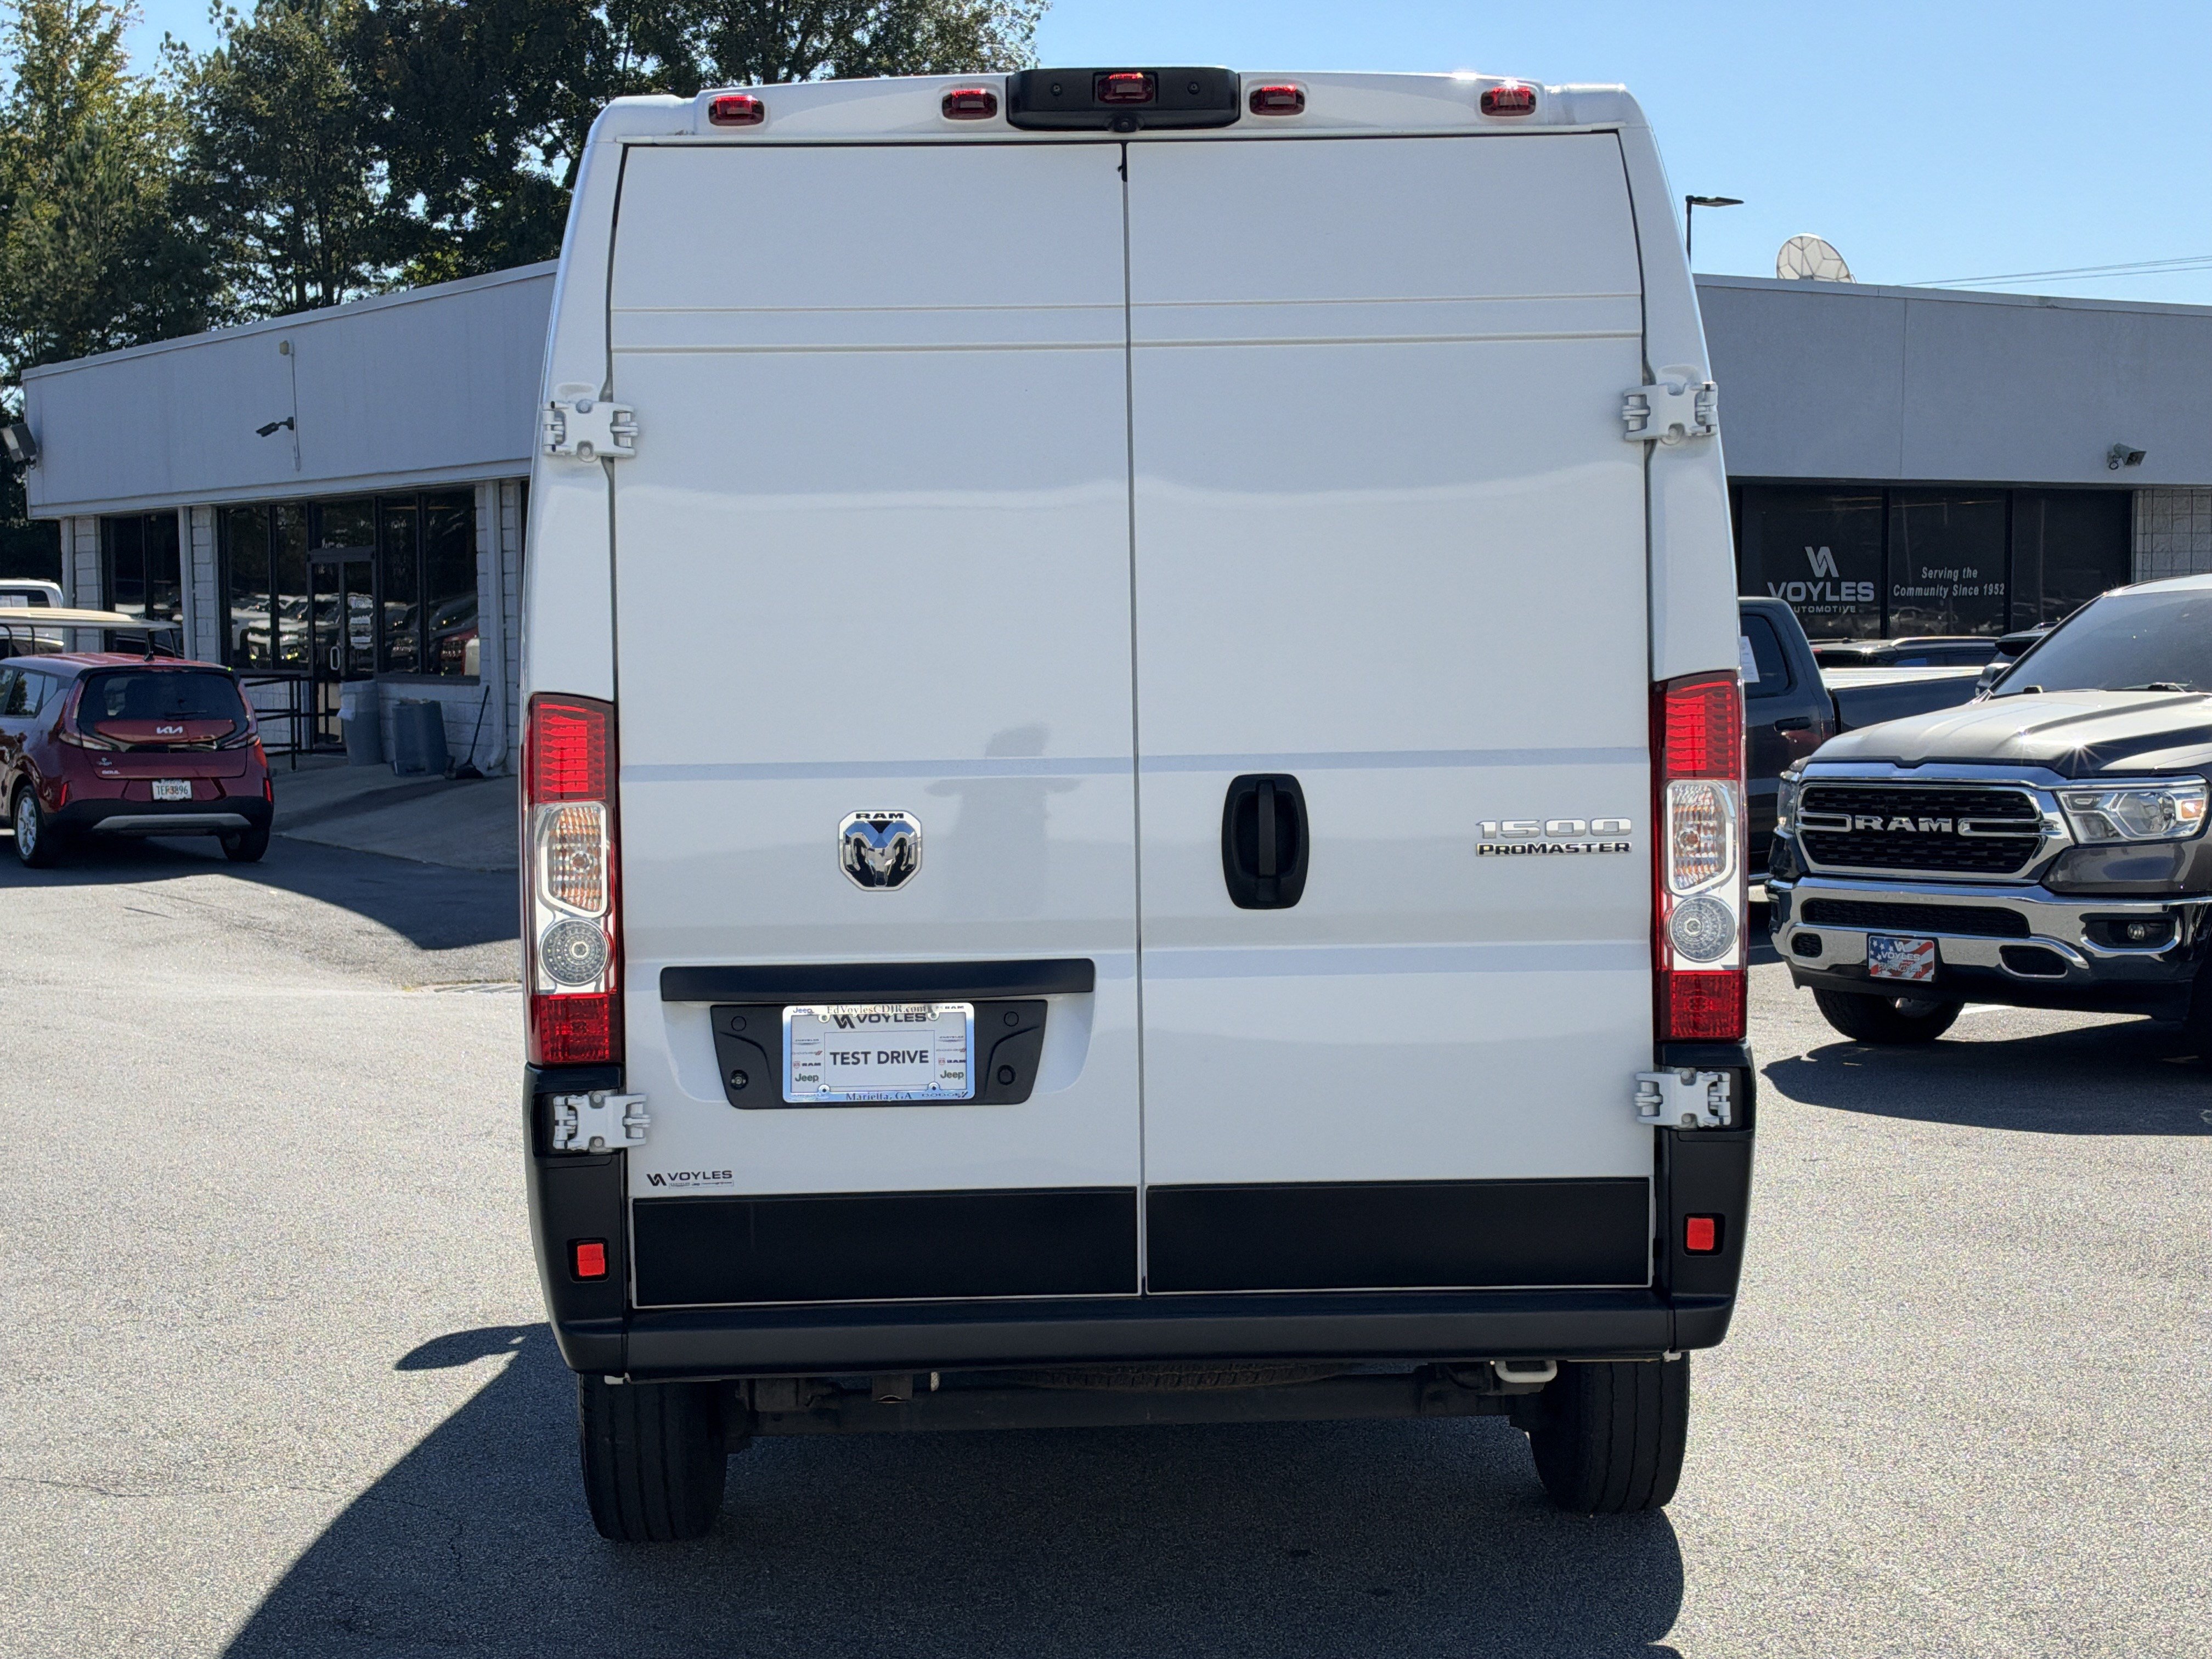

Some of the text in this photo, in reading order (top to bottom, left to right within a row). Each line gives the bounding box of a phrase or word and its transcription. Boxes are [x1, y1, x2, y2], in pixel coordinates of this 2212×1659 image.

[1921, 566, 1978, 582] Serving the
[1767, 582, 1875, 602] VOYLES
[1893, 583, 2005, 599] Community Since 1952
[1793, 606, 1856, 614] UTOMOTIVE
[1476, 818, 1632, 839] 1500
[1855, 814, 1953, 833] RAM
[1881, 951, 1921, 961] VOYLES
[856, 1013, 927, 1023] VOYLES
[830, 1050, 929, 1065] TEST DRIVE
[795, 1073, 819, 1083] Jeep
[940, 1070, 964, 1080] Jeep
[846, 1092, 913, 1101] Marietta, GA
[667, 1170, 732, 1181] VOYLES
